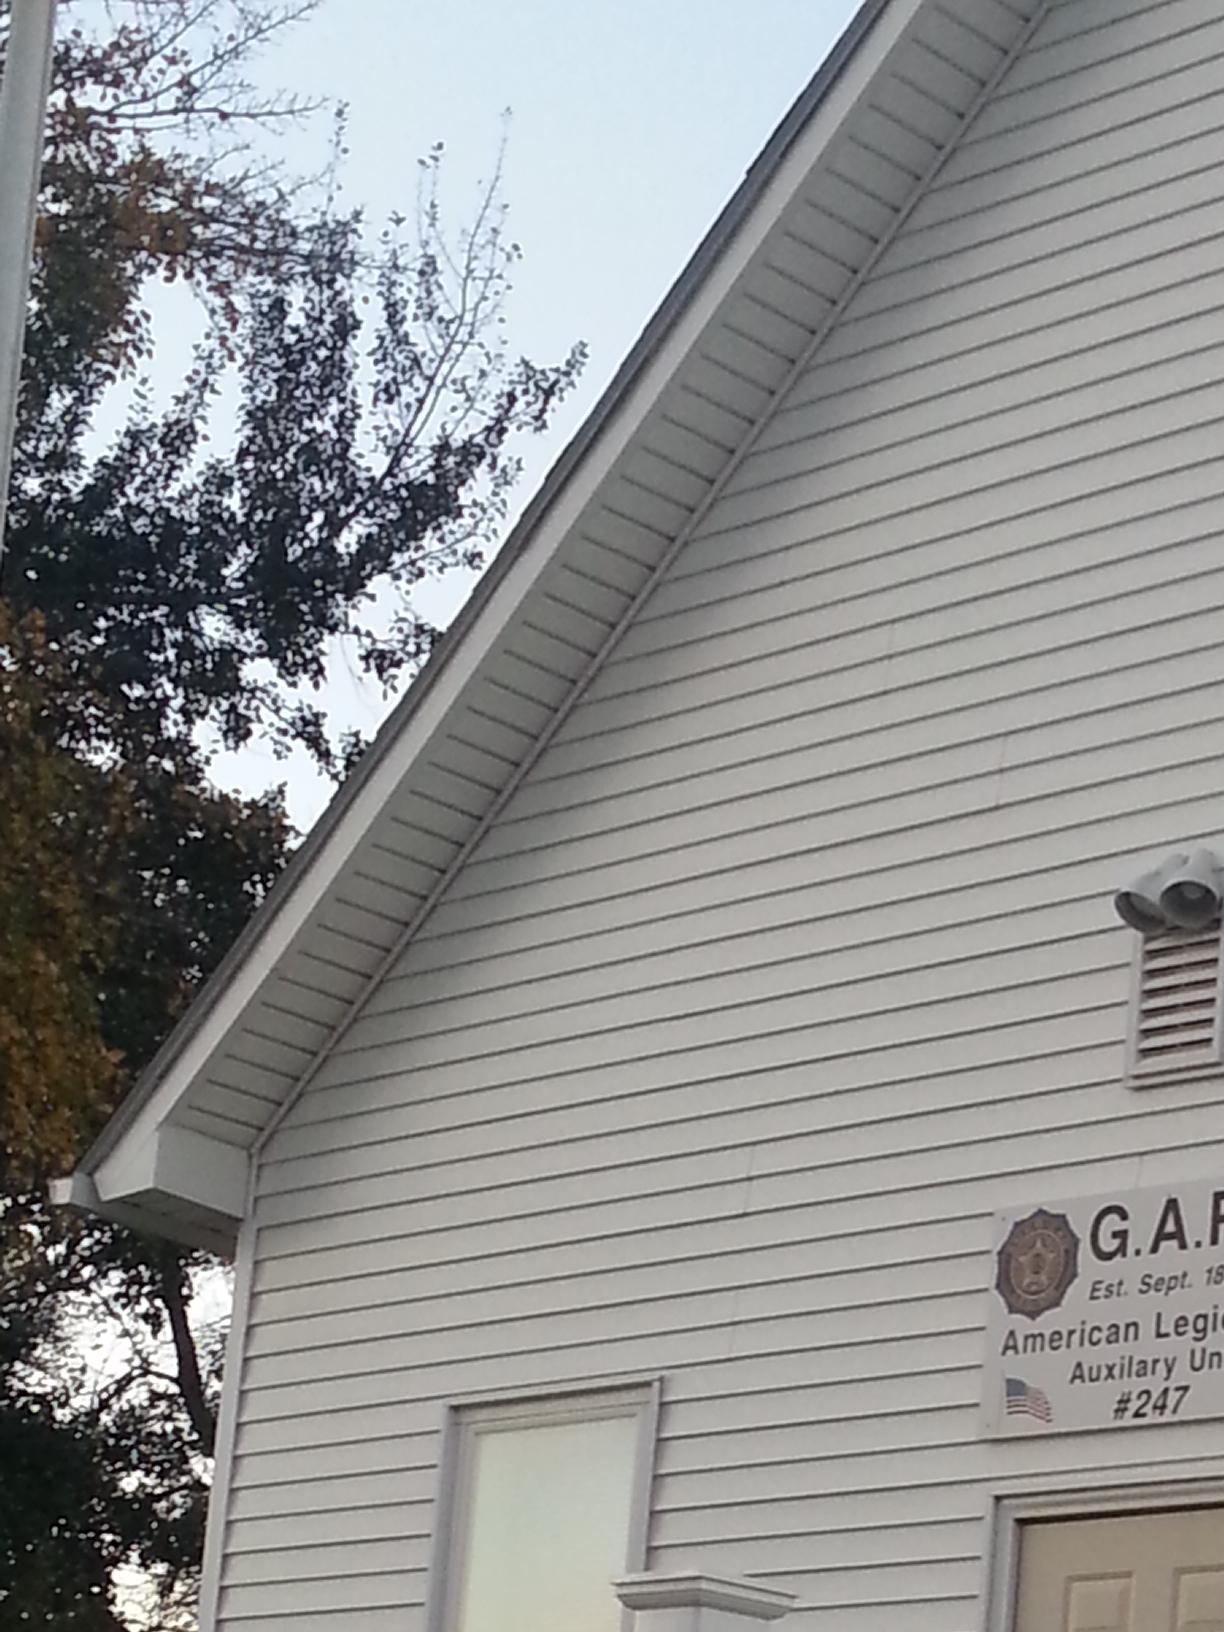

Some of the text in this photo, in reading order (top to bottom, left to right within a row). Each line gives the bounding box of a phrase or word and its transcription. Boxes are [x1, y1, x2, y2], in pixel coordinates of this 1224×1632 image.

[1088, 1280, 1128, 1301] Est.
[1138, 1272, 1192, 1296] Sept.
[1001, 1319, 1140, 1357] American
[1069, 1353, 1177, 1385] Auxilary
[1112, 1385, 1190, 1420] #247
